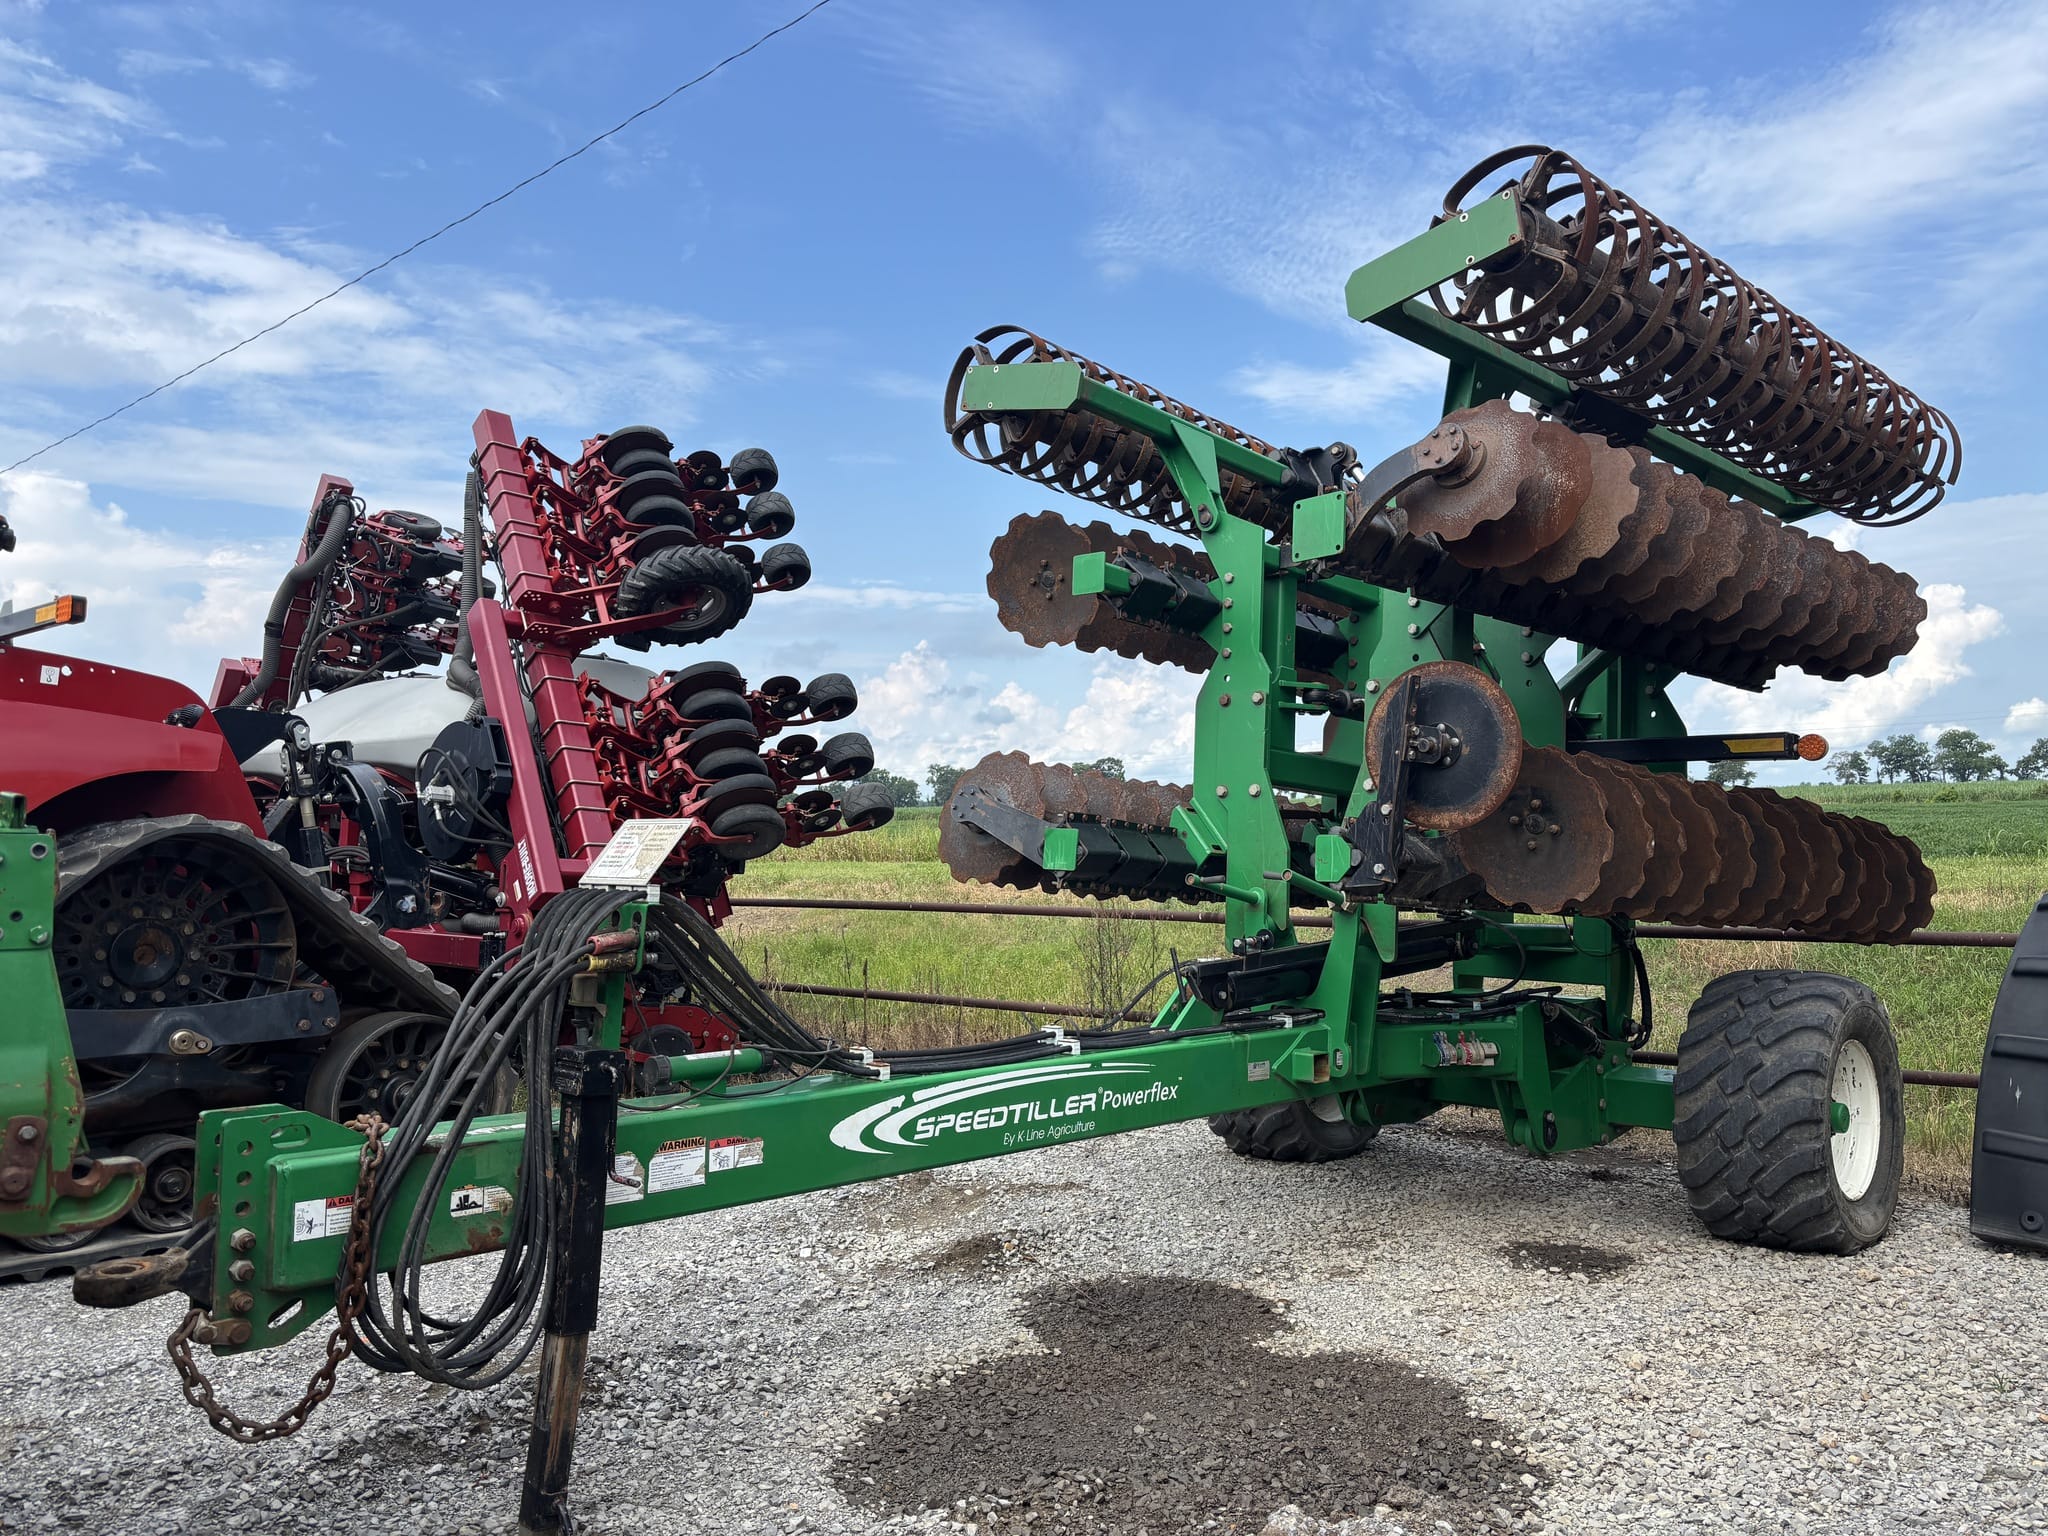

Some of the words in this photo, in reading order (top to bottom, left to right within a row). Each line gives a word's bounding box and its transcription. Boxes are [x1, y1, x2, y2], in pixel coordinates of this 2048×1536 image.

[1101, 1082, 1179, 1110] Powerflex
[1047, 1121, 1096, 1140] Agriculture
[659, 1137, 705, 1151] WARNING
